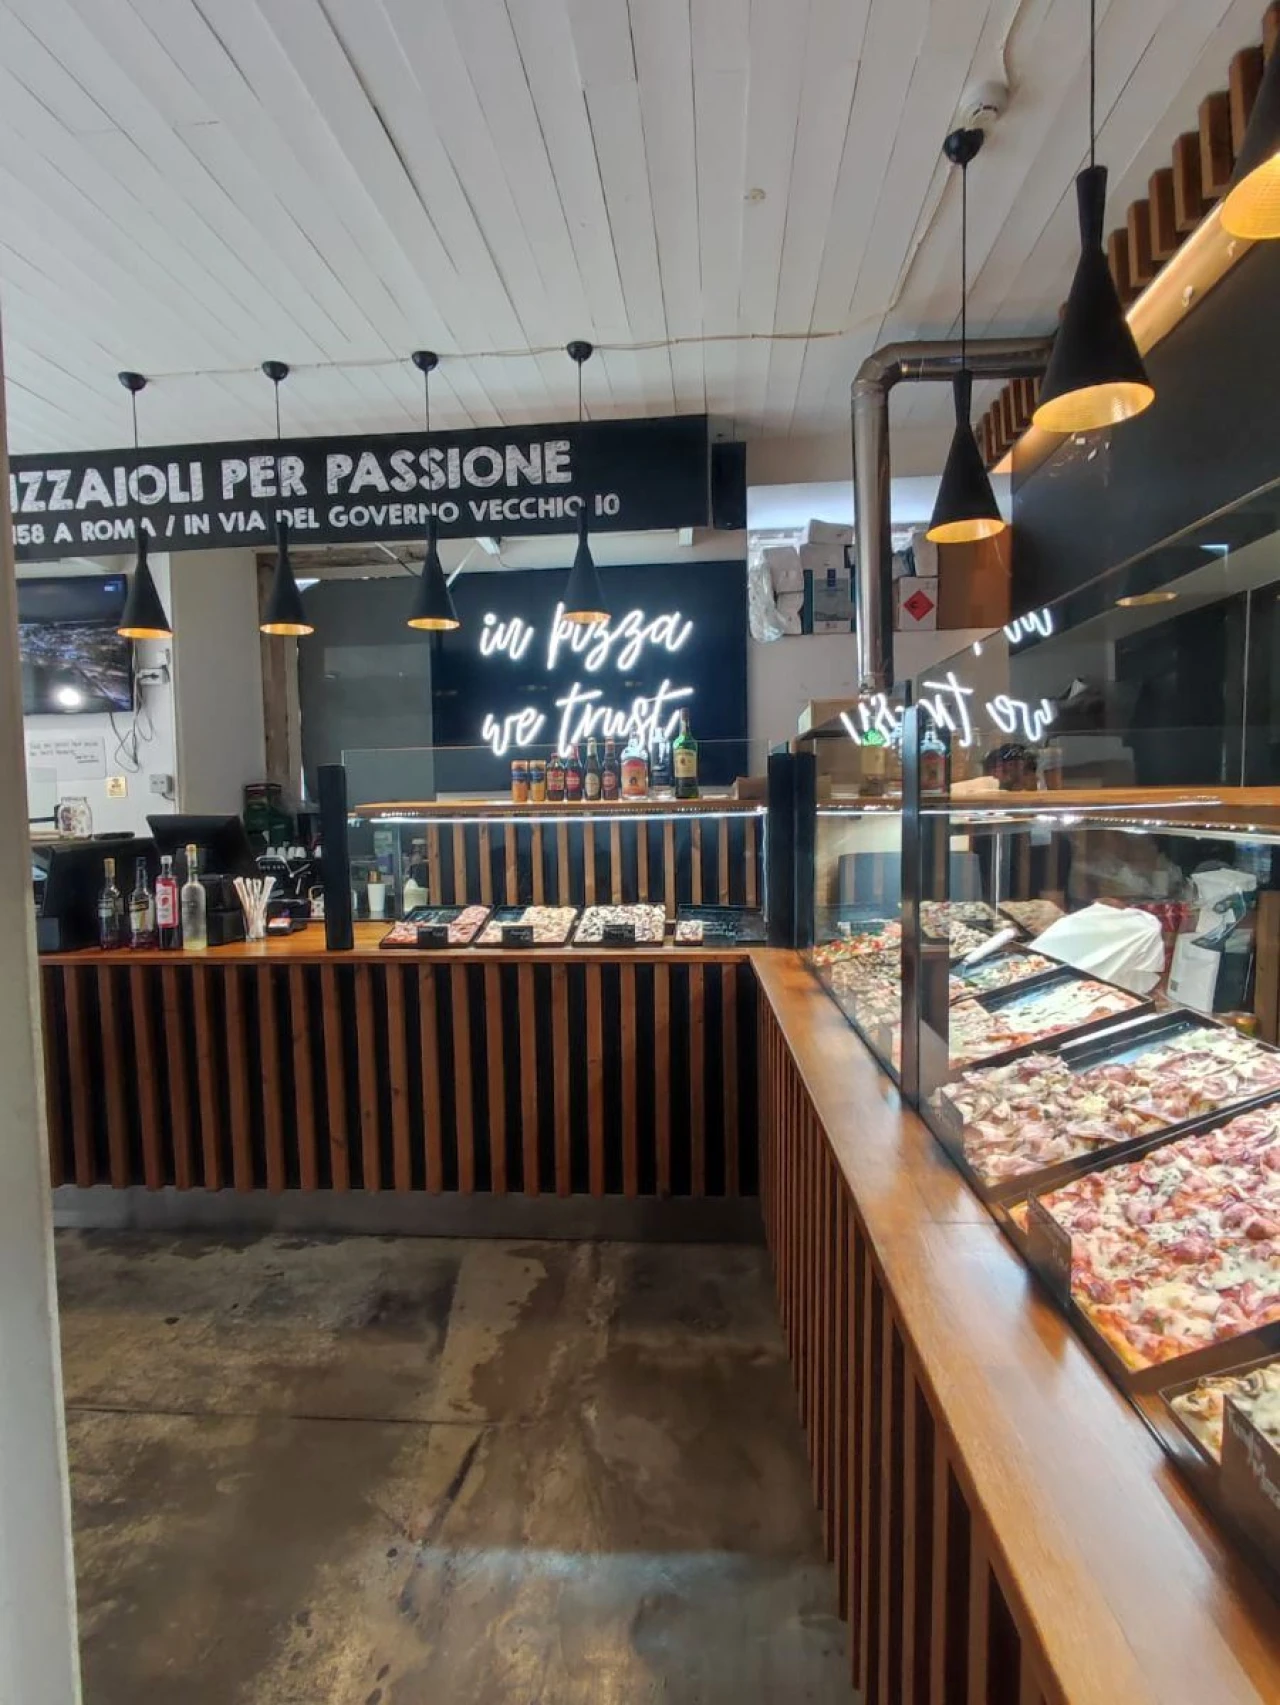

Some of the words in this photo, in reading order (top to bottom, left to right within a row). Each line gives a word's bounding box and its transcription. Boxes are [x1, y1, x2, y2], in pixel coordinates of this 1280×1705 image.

[221, 455, 307, 500] PER
[326, 440, 572, 495] PASSIONE
[53, 522, 73, 544] A
[80, 517, 157, 541] ROMA
[165, 514, 176, 537] /
[184, 513, 210, 535] IN
[218, 509, 266, 533] VIA
[275, 507, 320, 530] DEL
[328, 501, 460, 528] GOVERNO
[468, 495, 586, 522] VECCHIO
[479, 612, 535, 661] in
[546, 601, 694, 671] pizza
[481, 706, 547, 757] we
[554, 678, 695, 759] trust
